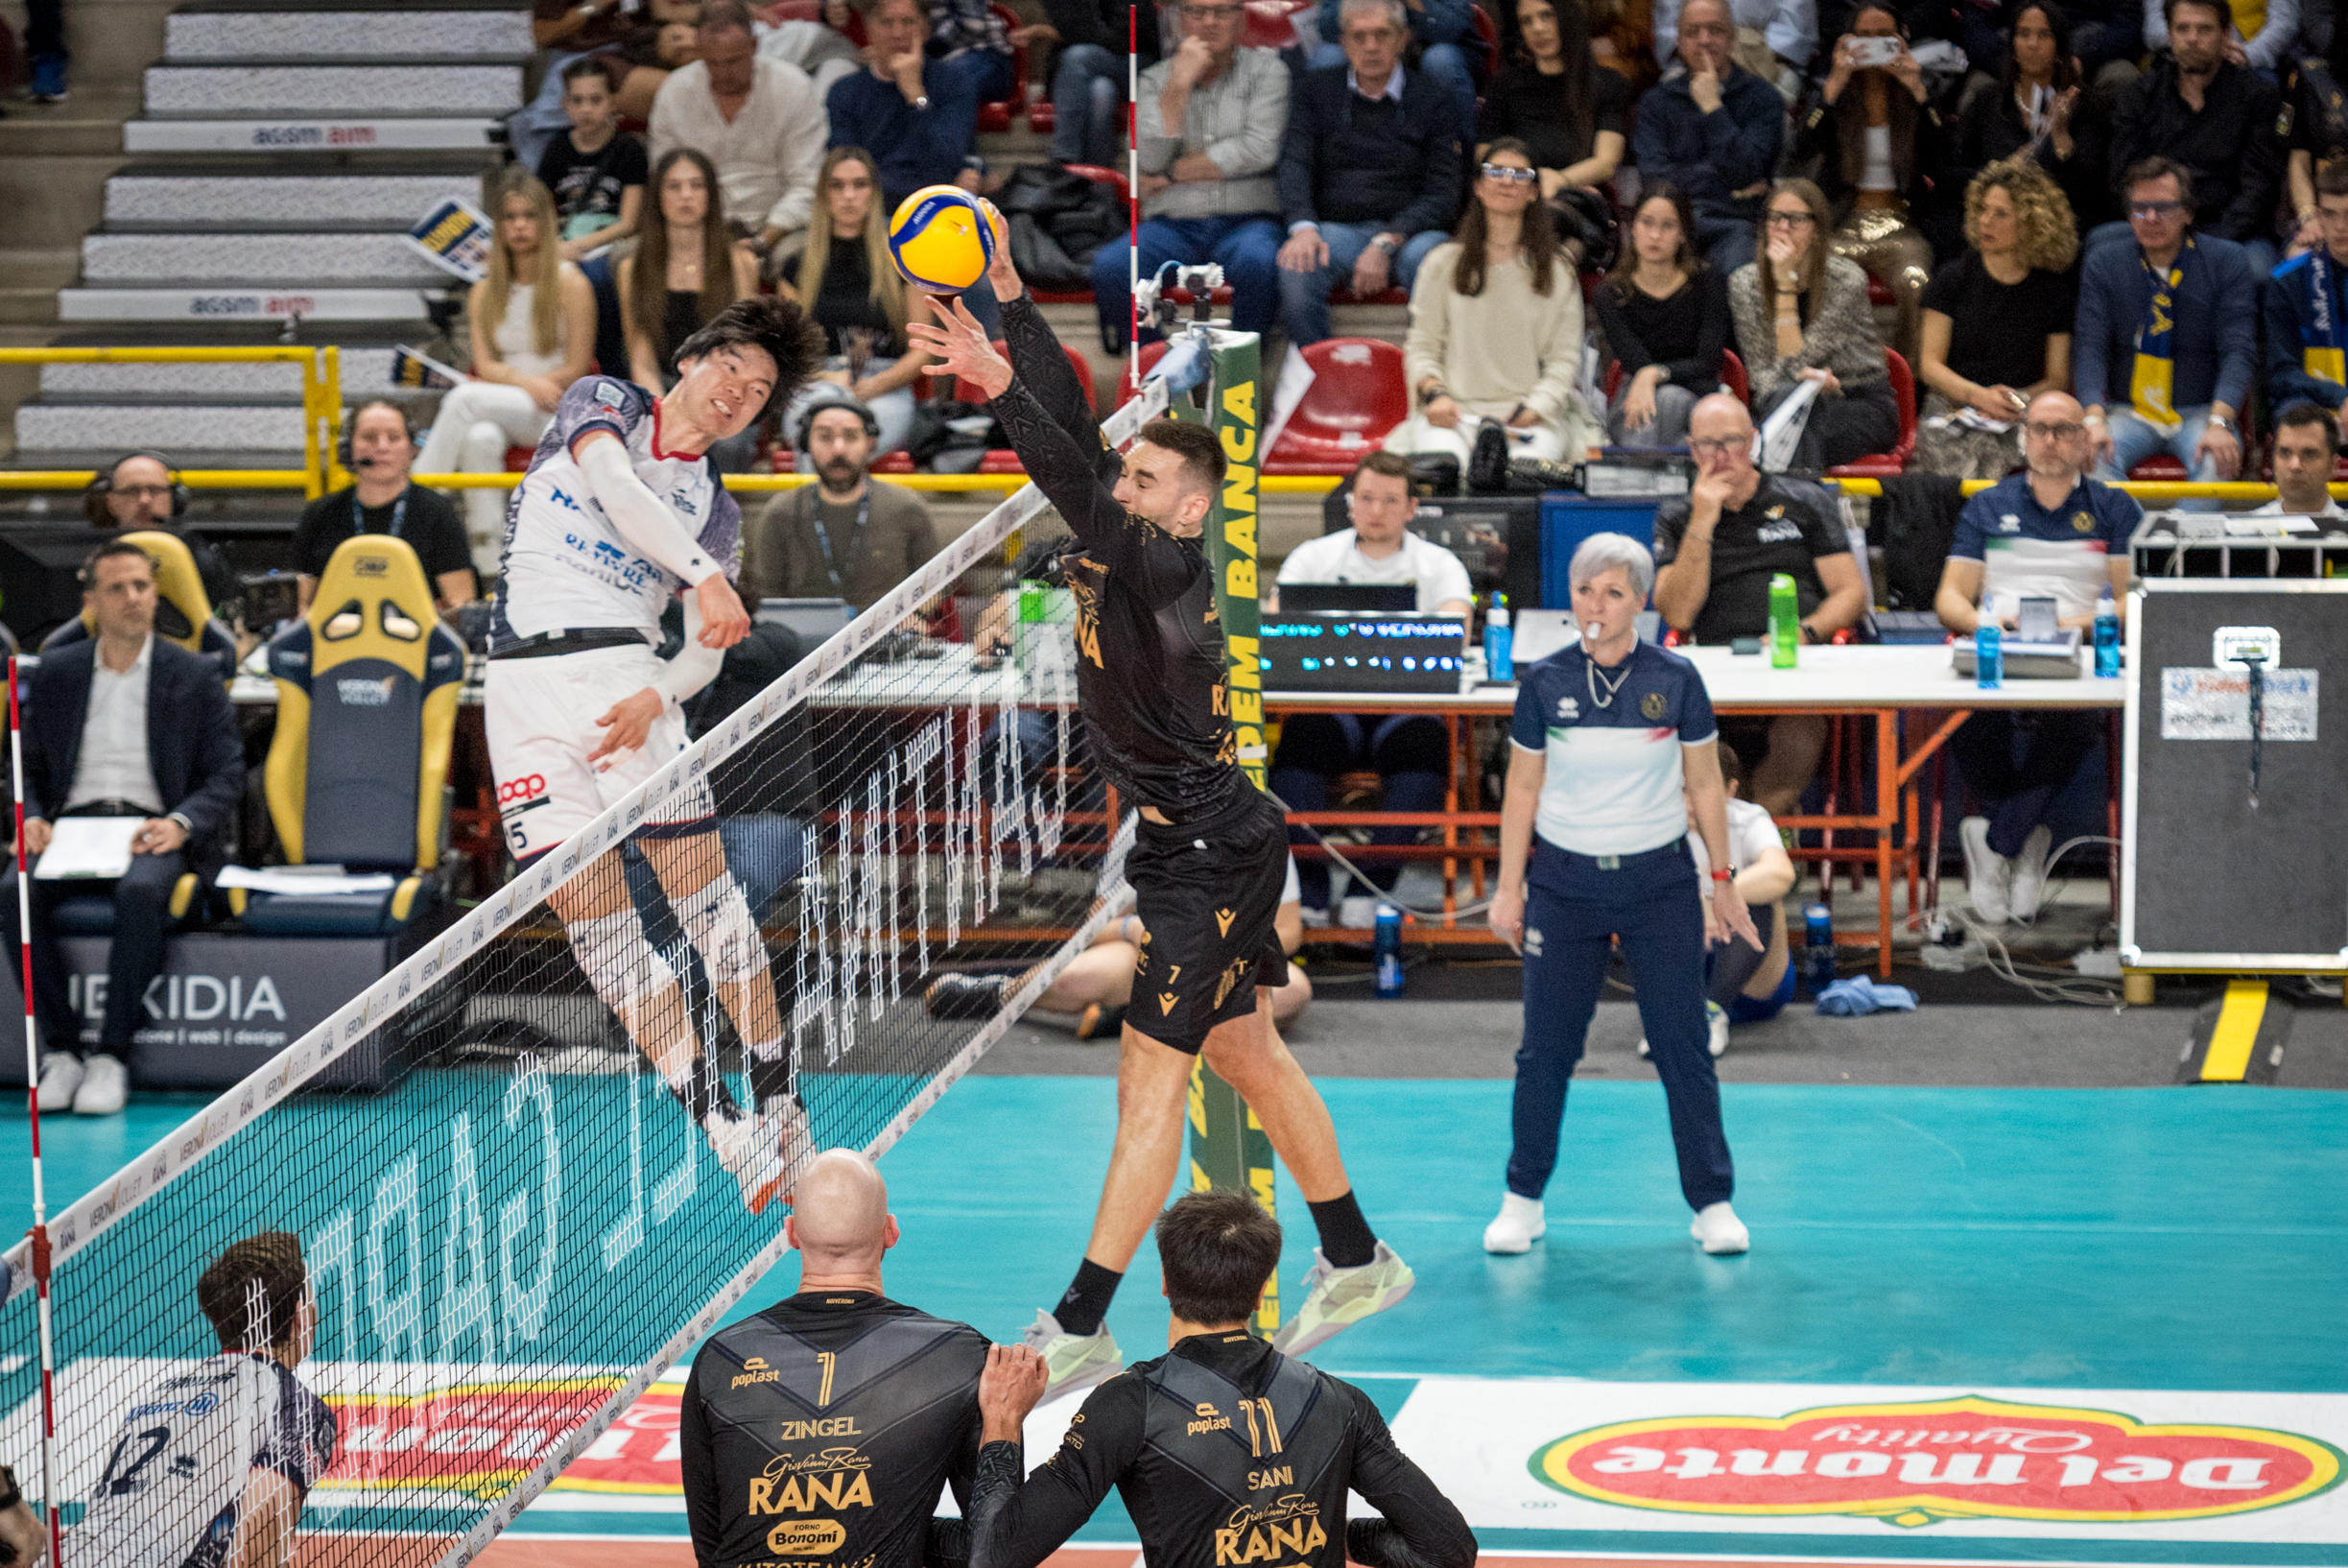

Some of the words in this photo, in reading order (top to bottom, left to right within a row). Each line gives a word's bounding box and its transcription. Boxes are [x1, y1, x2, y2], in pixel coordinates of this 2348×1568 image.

[1220, 380, 1259, 600] BANCA
[1168, 964, 1182, 985] 7
[68, 973, 287, 1022] EXIDIA
[731, 1369, 779, 1390] poplast
[781, 1416, 862, 1440] ZINGEL
[1187, 1415, 1232, 1437] poplast
[1238, 1396, 1283, 1458] 11
[1812, 1422, 2094, 1453] Quality
[93, 1426, 171, 1499] 12
[820, 1446, 872, 1470] Rana
[1593, 1444, 2029, 1485] Monte
[2057, 1453, 2275, 1491] Del
[748, 1469, 874, 1515] RANA
[1247, 1465, 1293, 1491] SANI
[775, 1531, 838, 1545] Bonomi
[1215, 1515, 1328, 1566] RANA
